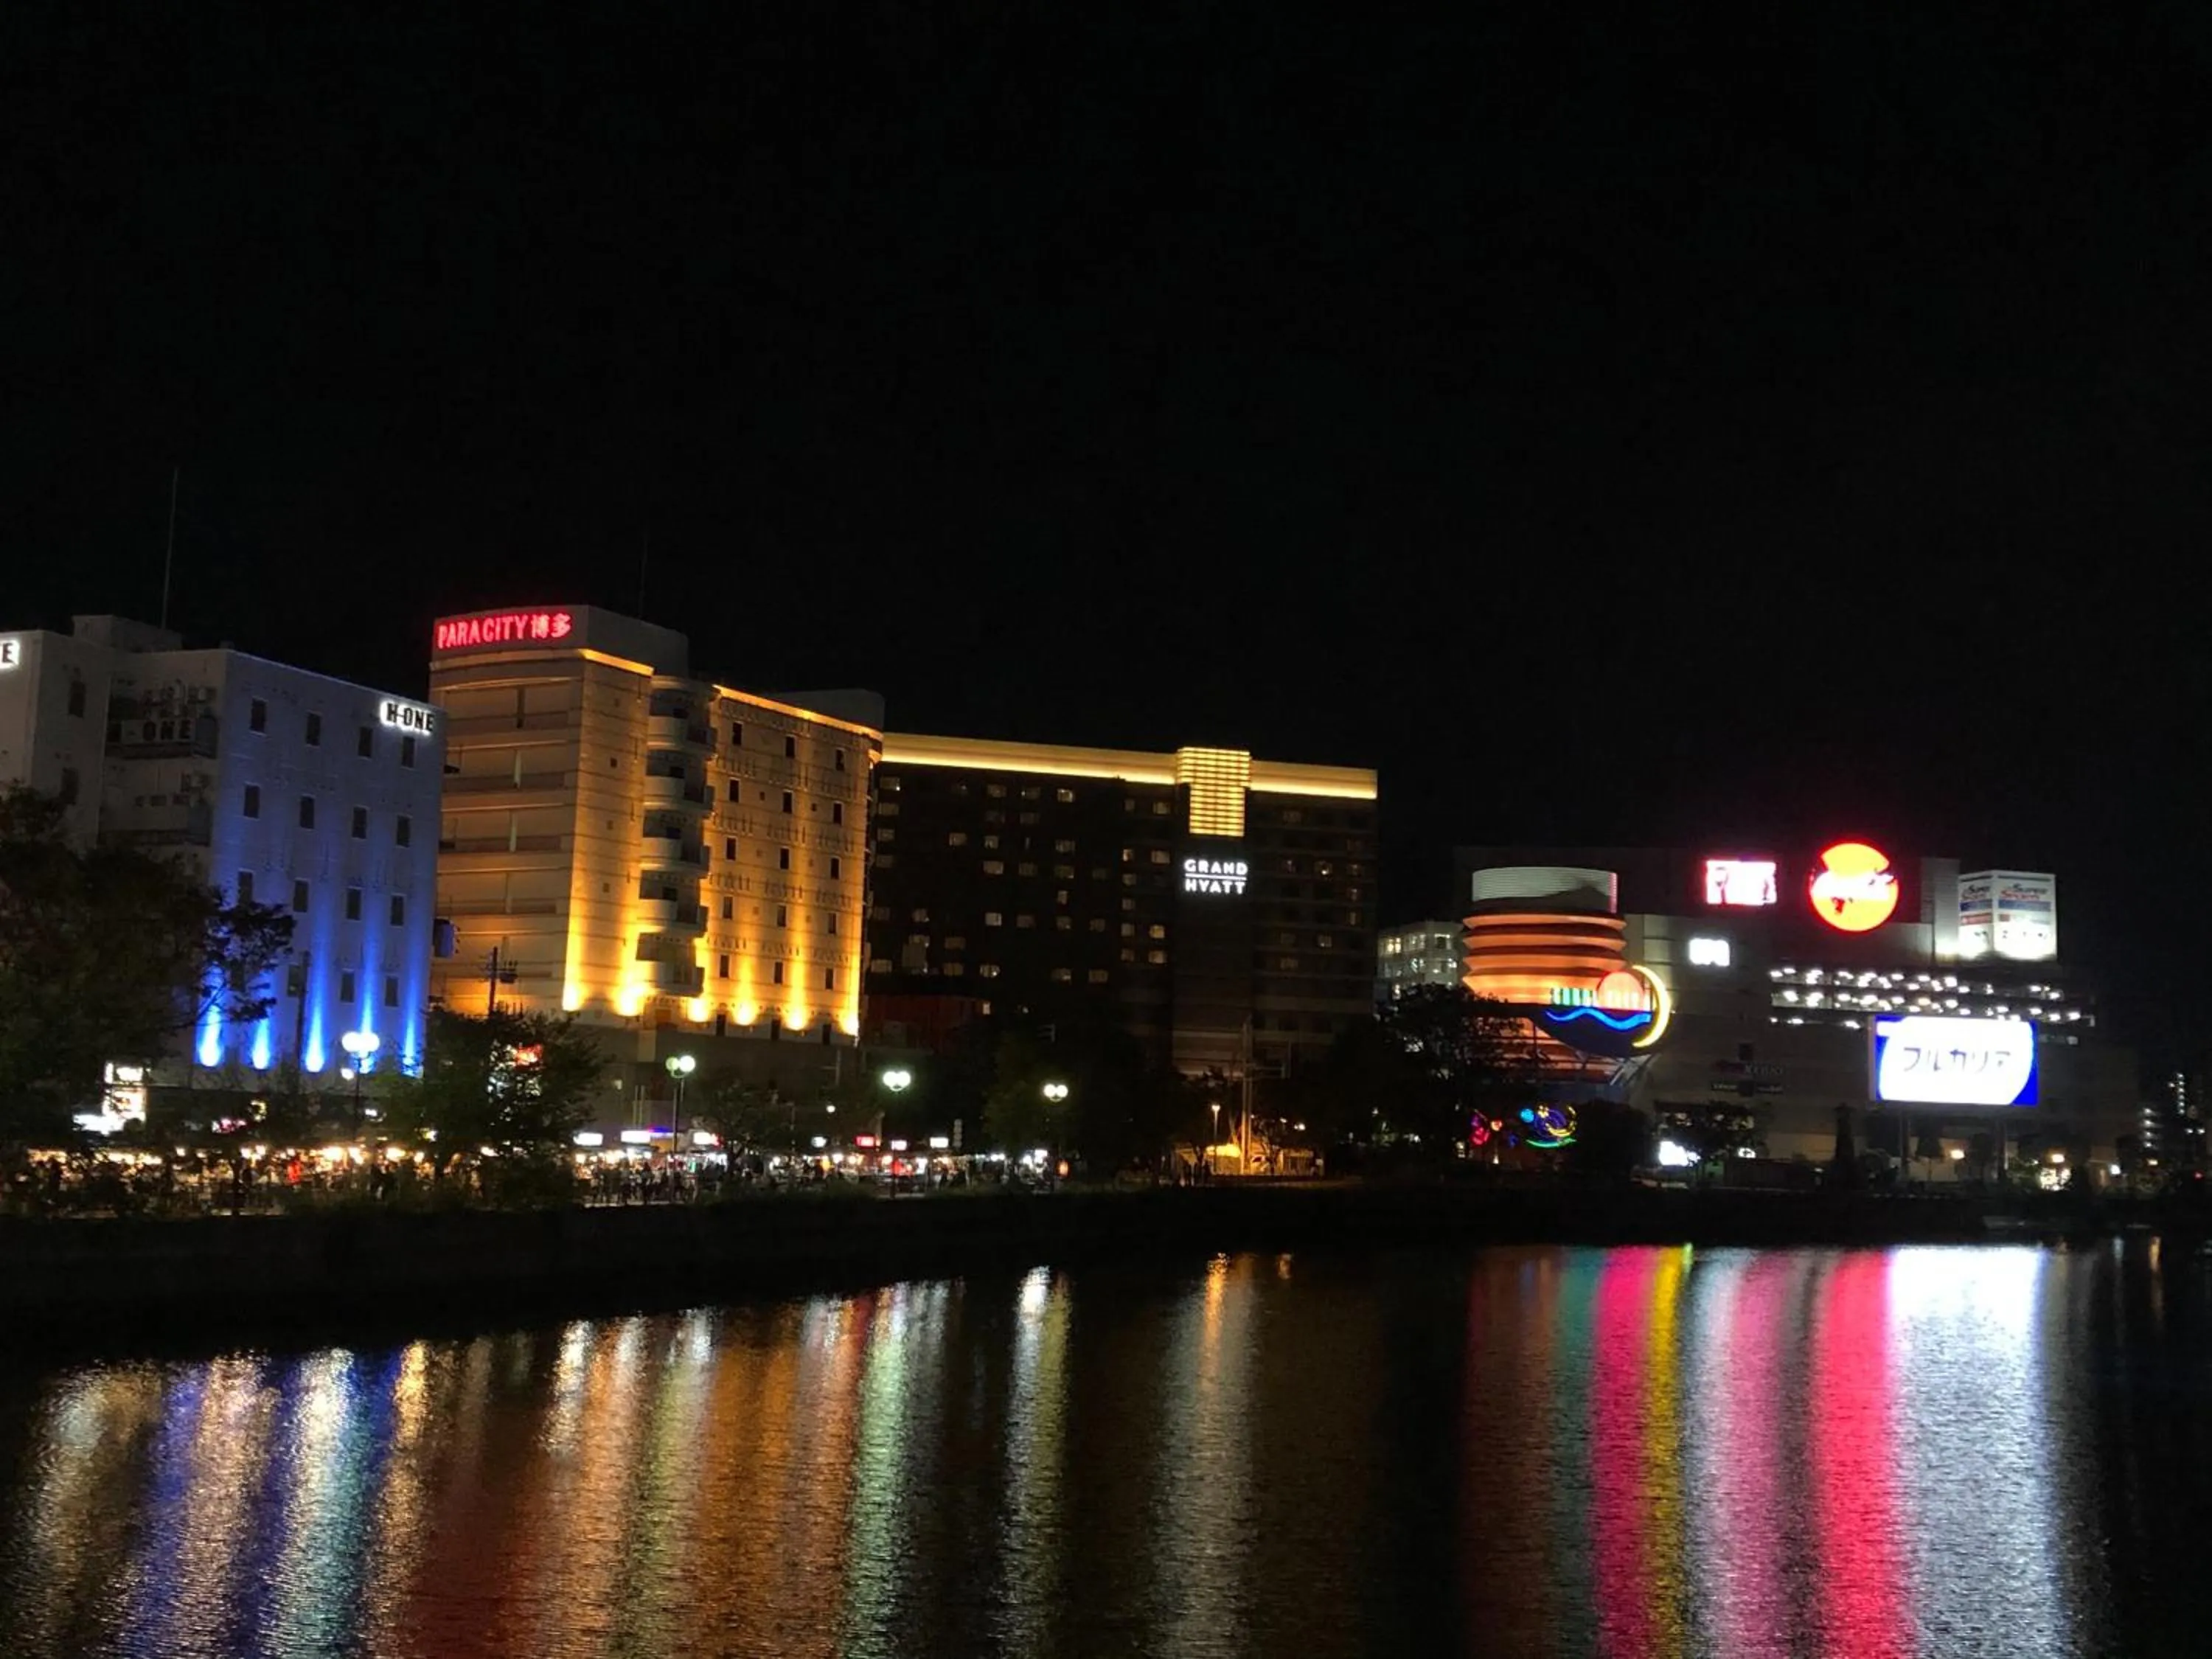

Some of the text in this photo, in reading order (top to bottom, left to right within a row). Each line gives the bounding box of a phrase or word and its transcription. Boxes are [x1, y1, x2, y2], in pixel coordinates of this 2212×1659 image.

[438, 614, 529, 649] PARACITY
[386, 703, 435, 731] H-ONE
[1184, 859, 1248, 875] GRAND
[1185, 878, 1245, 894] HYATT
